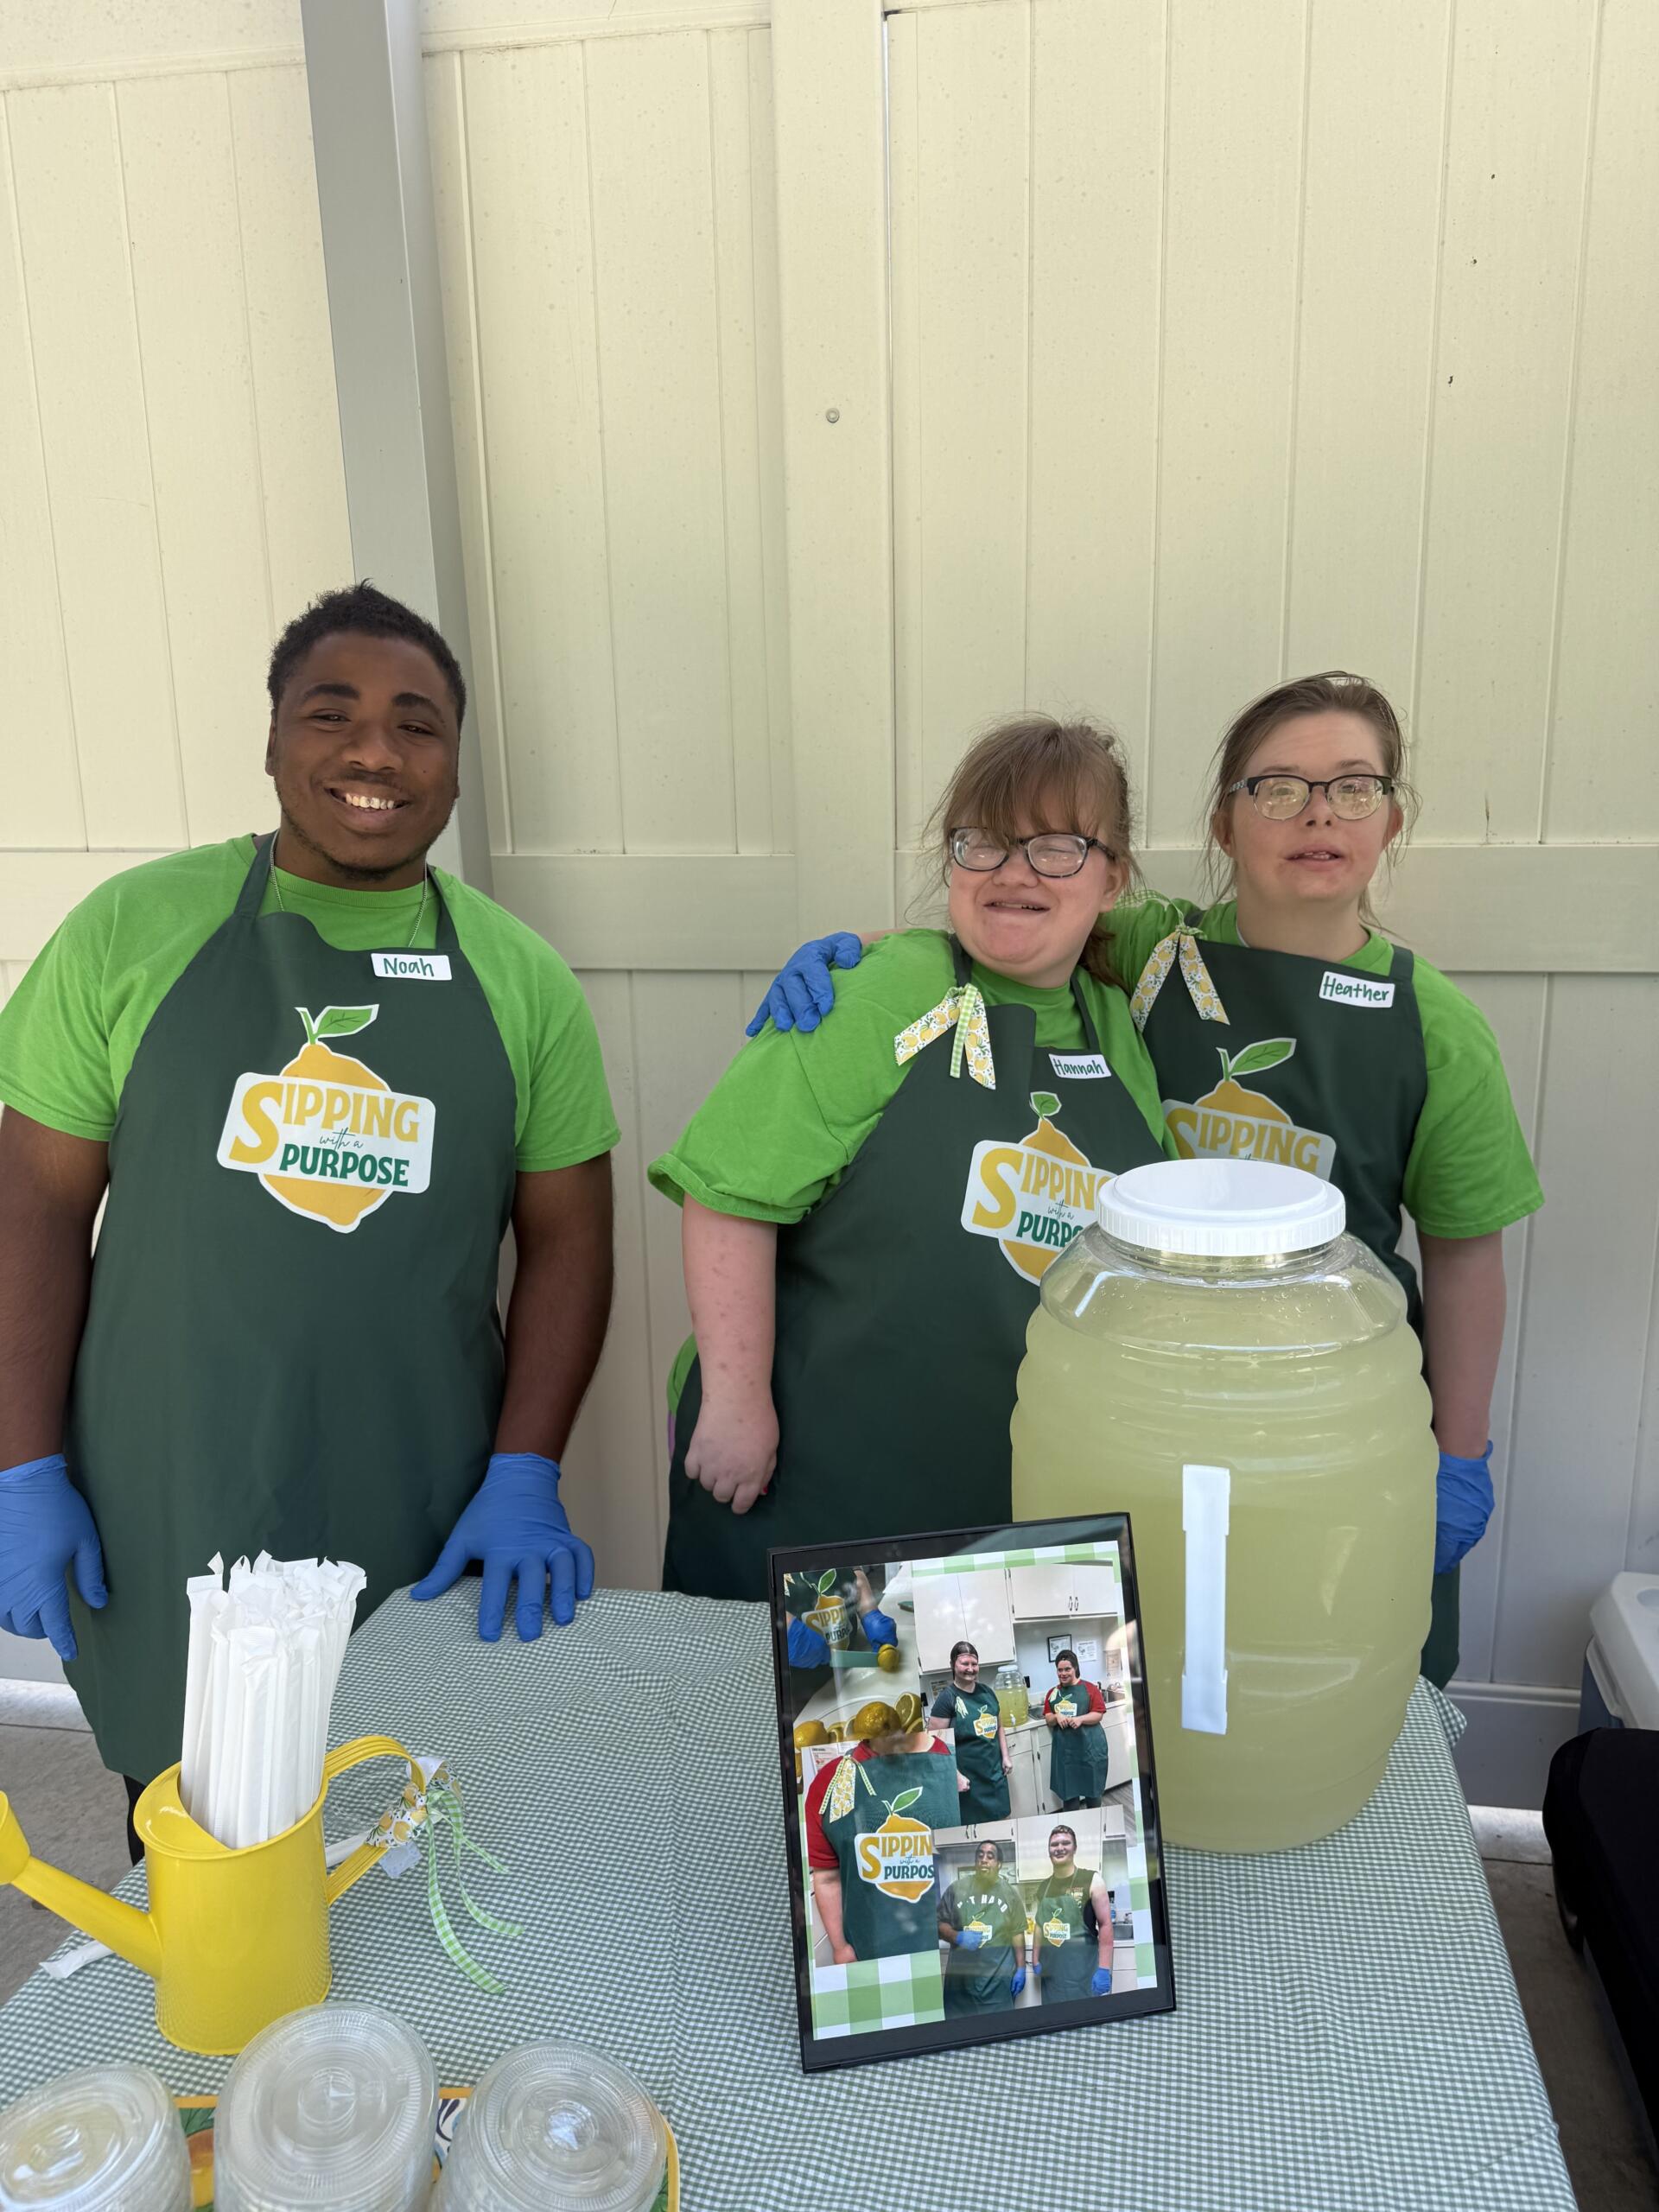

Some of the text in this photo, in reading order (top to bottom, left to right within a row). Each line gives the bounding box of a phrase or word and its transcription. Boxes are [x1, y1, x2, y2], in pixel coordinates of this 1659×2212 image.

[383, 957, 435, 977] Noah
[1323, 975, 1389, 1001] Heather
[1052, 1058, 1105, 1076] Hannah
[228, 1081, 420, 1164] SIPPING
[319, 1127, 356, 1150] with
[279, 1143, 410, 1187] PURPOSE
[884, 1865, 935, 1879] PURPOS
